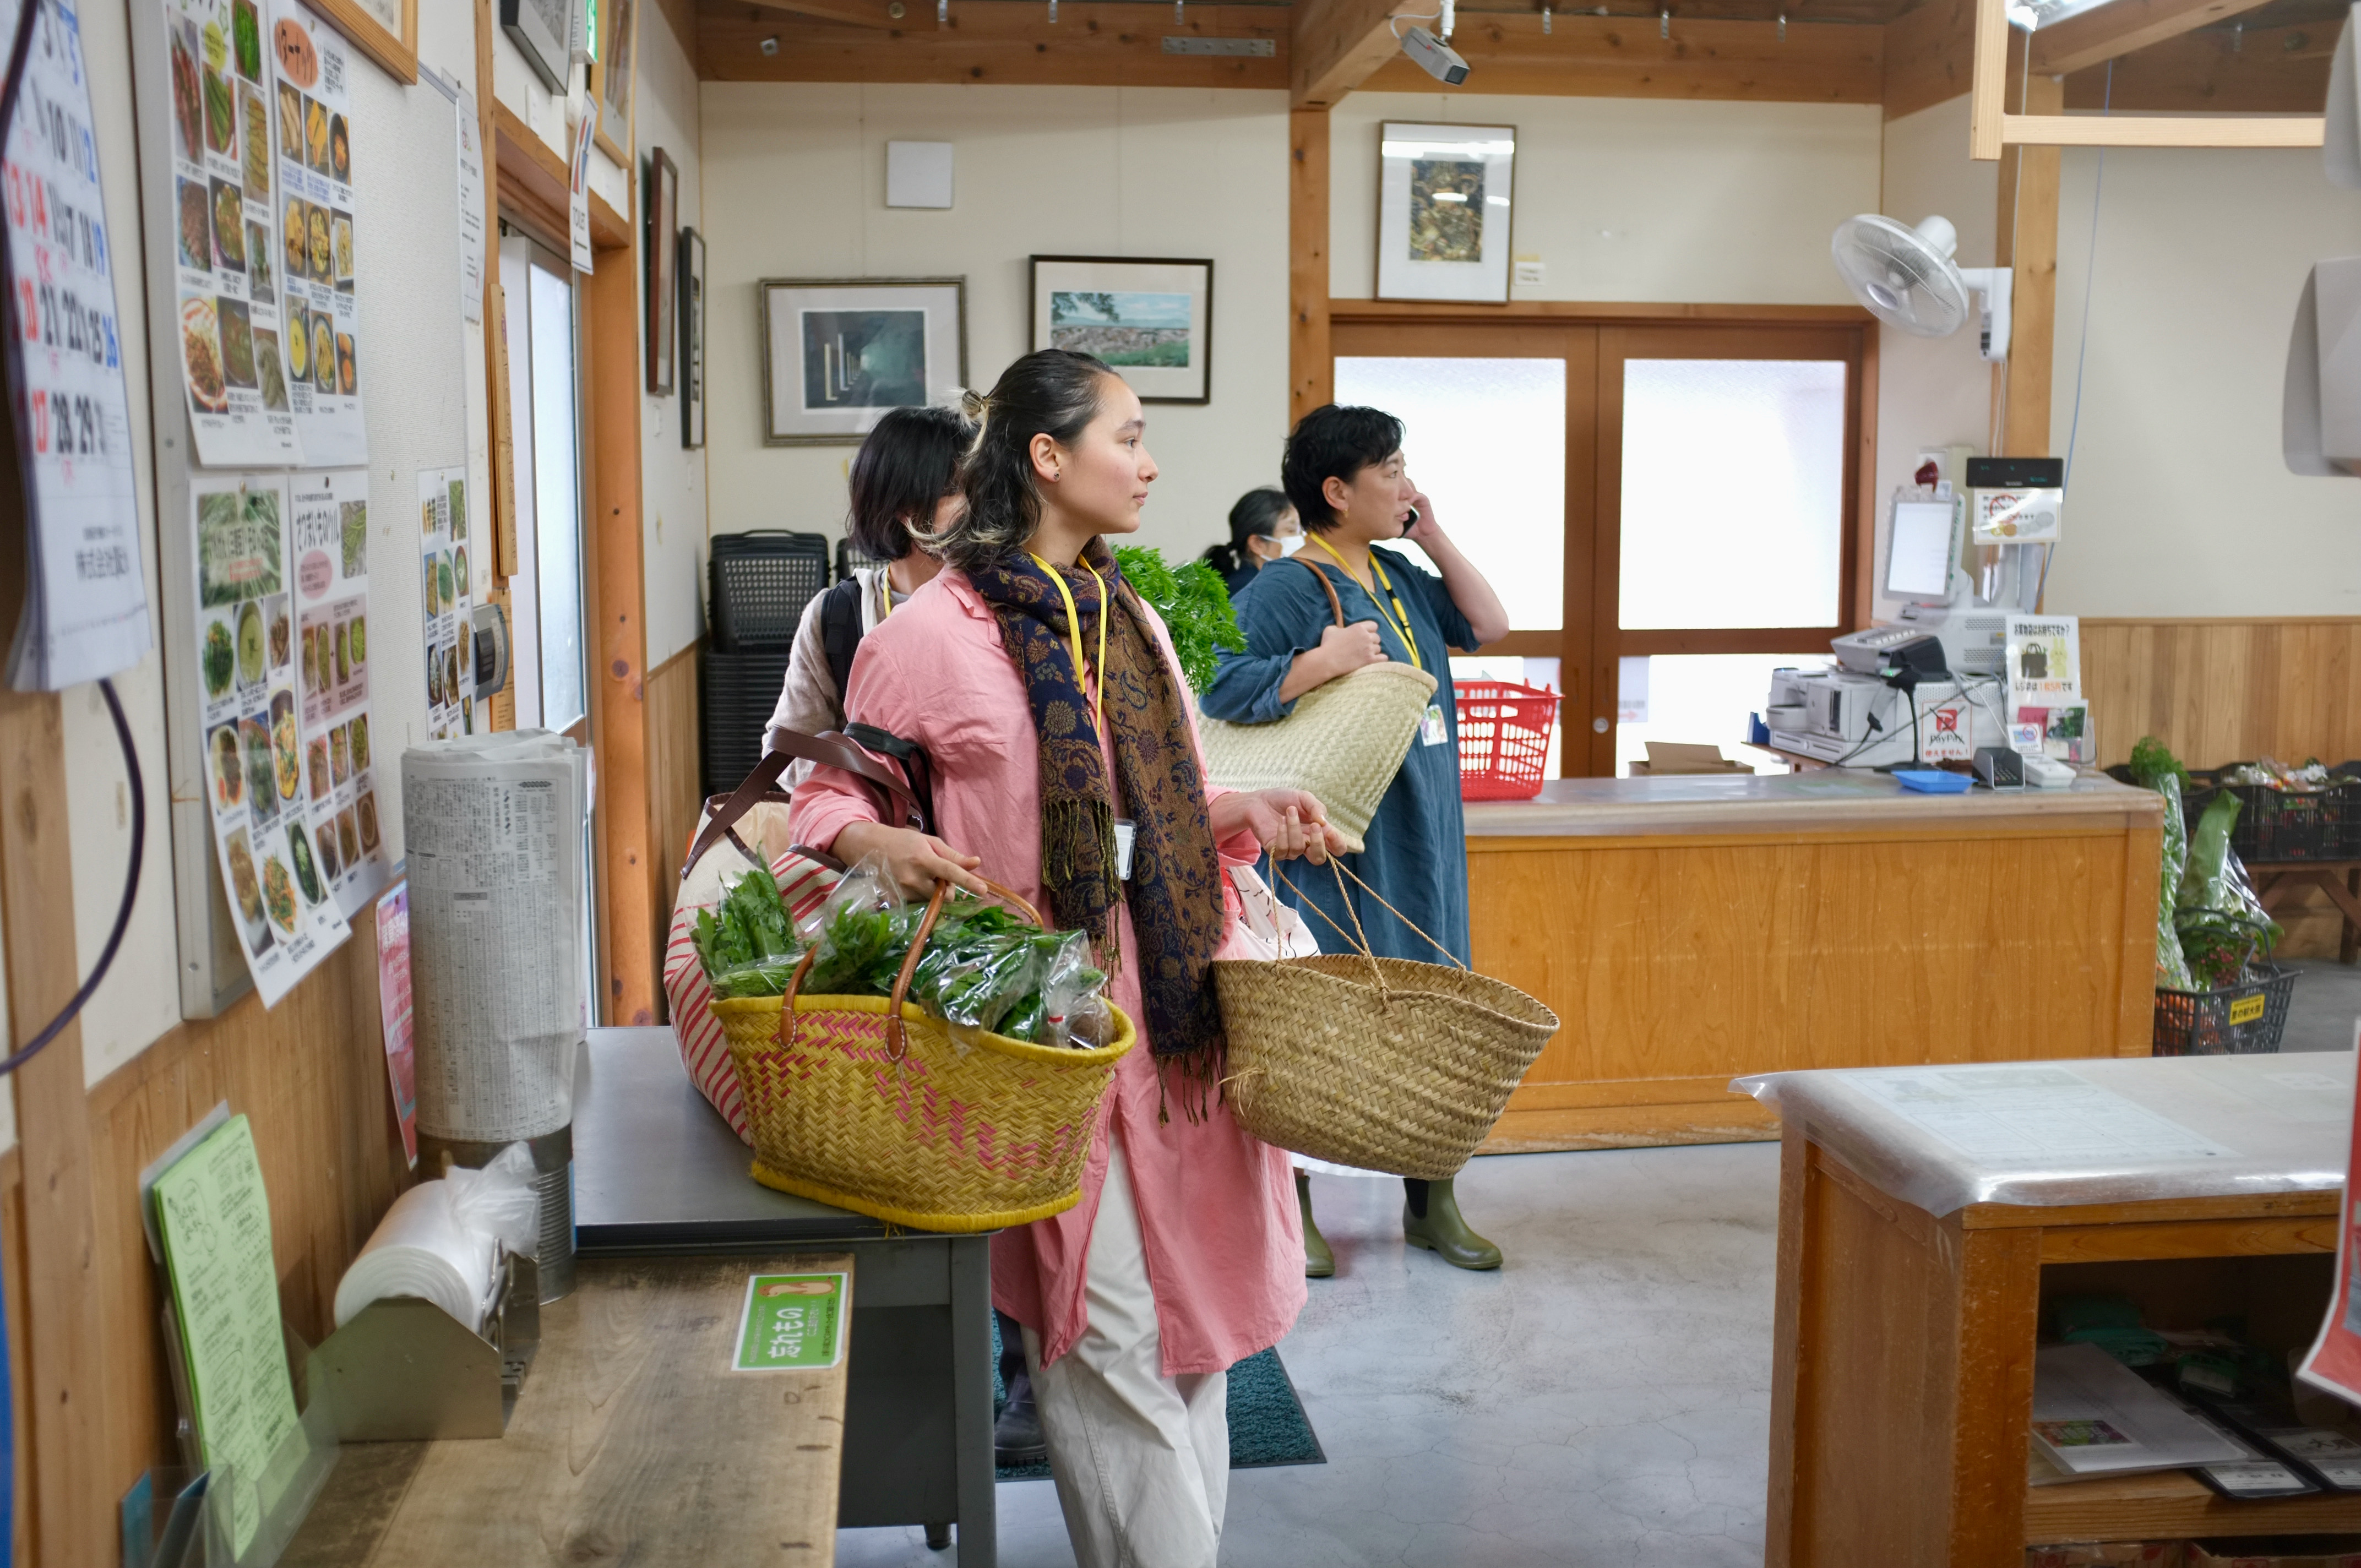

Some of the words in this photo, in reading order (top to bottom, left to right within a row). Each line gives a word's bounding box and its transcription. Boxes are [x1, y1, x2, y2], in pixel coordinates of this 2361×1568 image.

[1930, 734, 1963, 744] PayPay
[767, 1307, 804, 1359] 忘れもの
